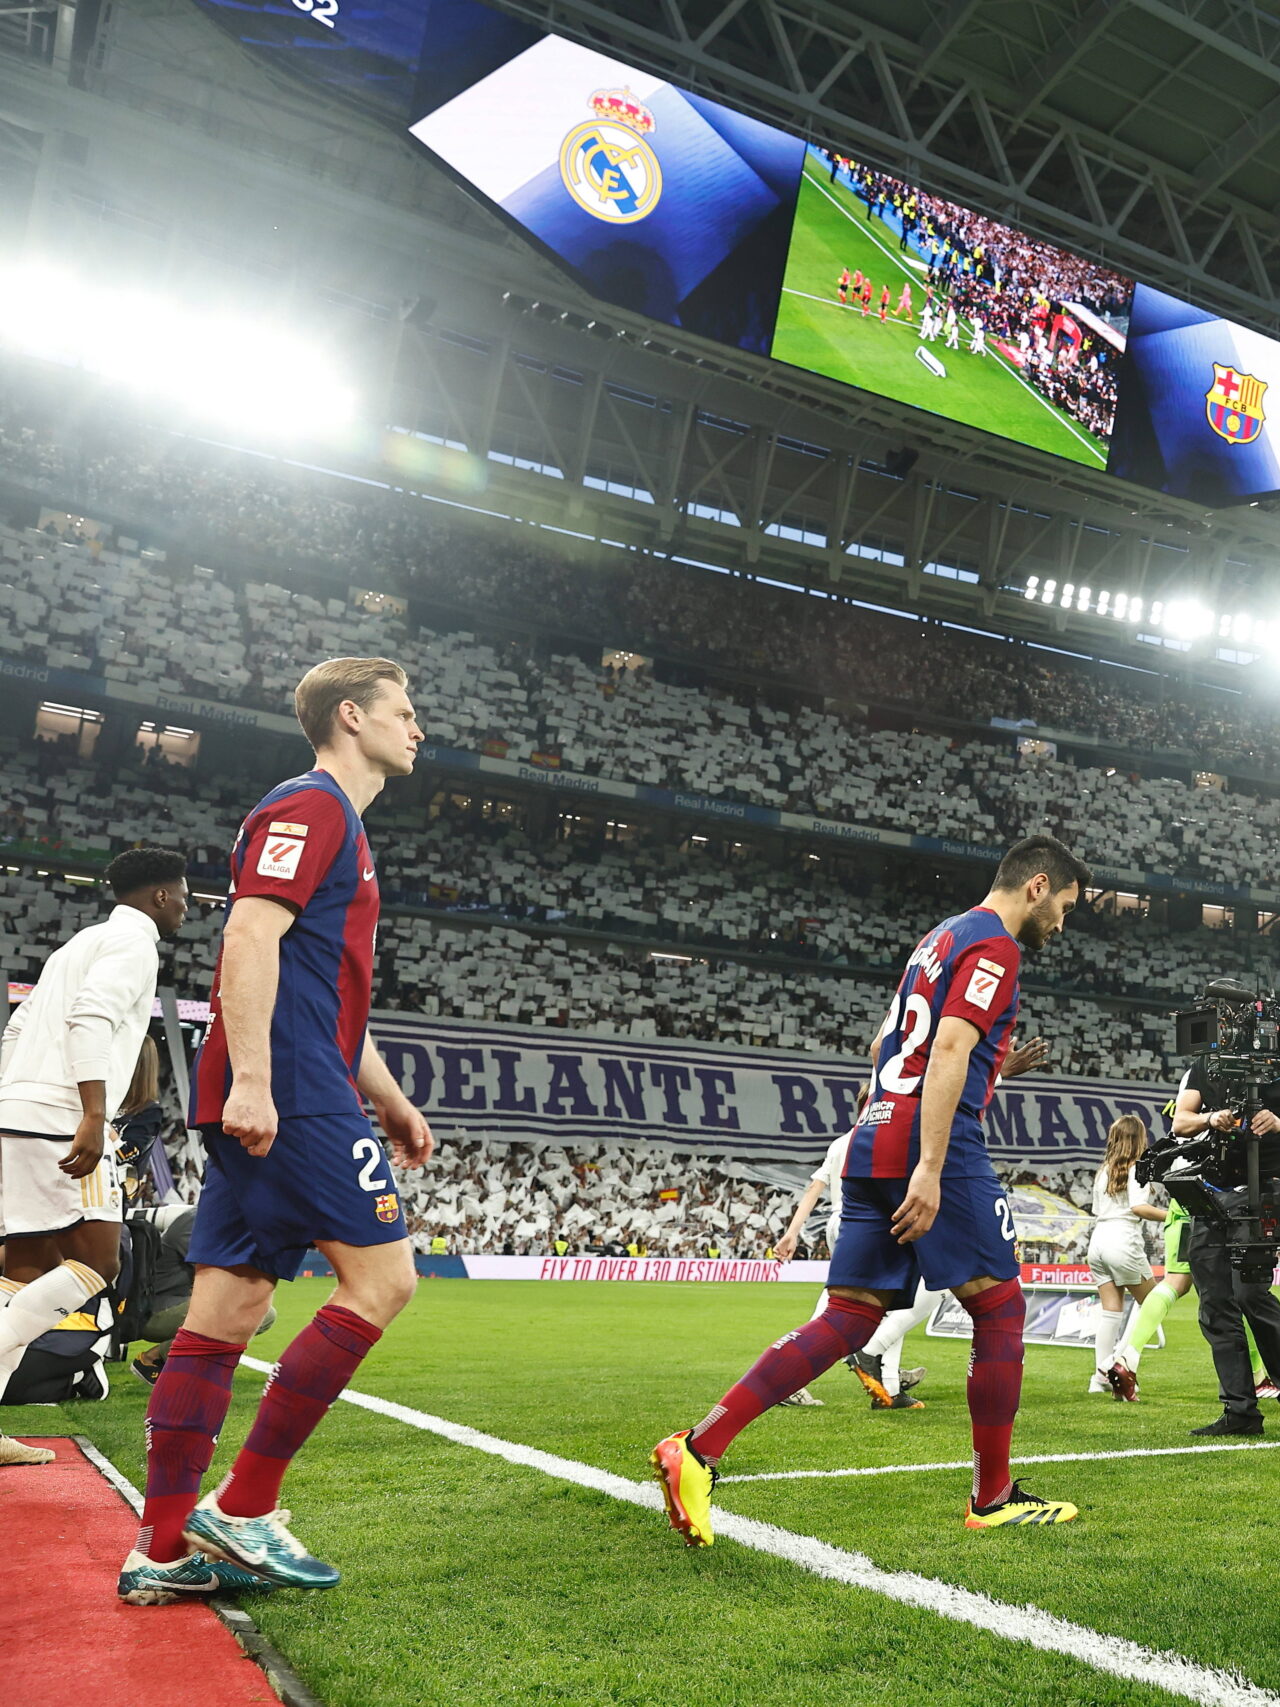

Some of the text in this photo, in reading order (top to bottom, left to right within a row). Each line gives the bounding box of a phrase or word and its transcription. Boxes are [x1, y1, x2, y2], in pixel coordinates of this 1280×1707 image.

[156, 696, 259, 727] Real Madrid
[519, 767, 599, 791] Real Madrid
[674, 795, 745, 818] Real Madrid
[812, 821, 880, 843] Real Madrid
[942, 842, 1002, 862] Real Madrid
[262, 863, 291, 874] LALIGA
[1172, 879, 1196, 892] Real
[362, 1040, 1177, 1147] DELANTE RE MADR
[352, 1137, 398, 1192] 2
[573, 1259, 592, 1281] TO
[596, 1260, 637, 1281] OVER
[642, 1261, 672, 1282] 130
[675, 1261, 782, 1283] DESTINATIONS
[1031, 1267, 1094, 1284] Emirates
[772, 1331, 803, 1350] BARÇA
